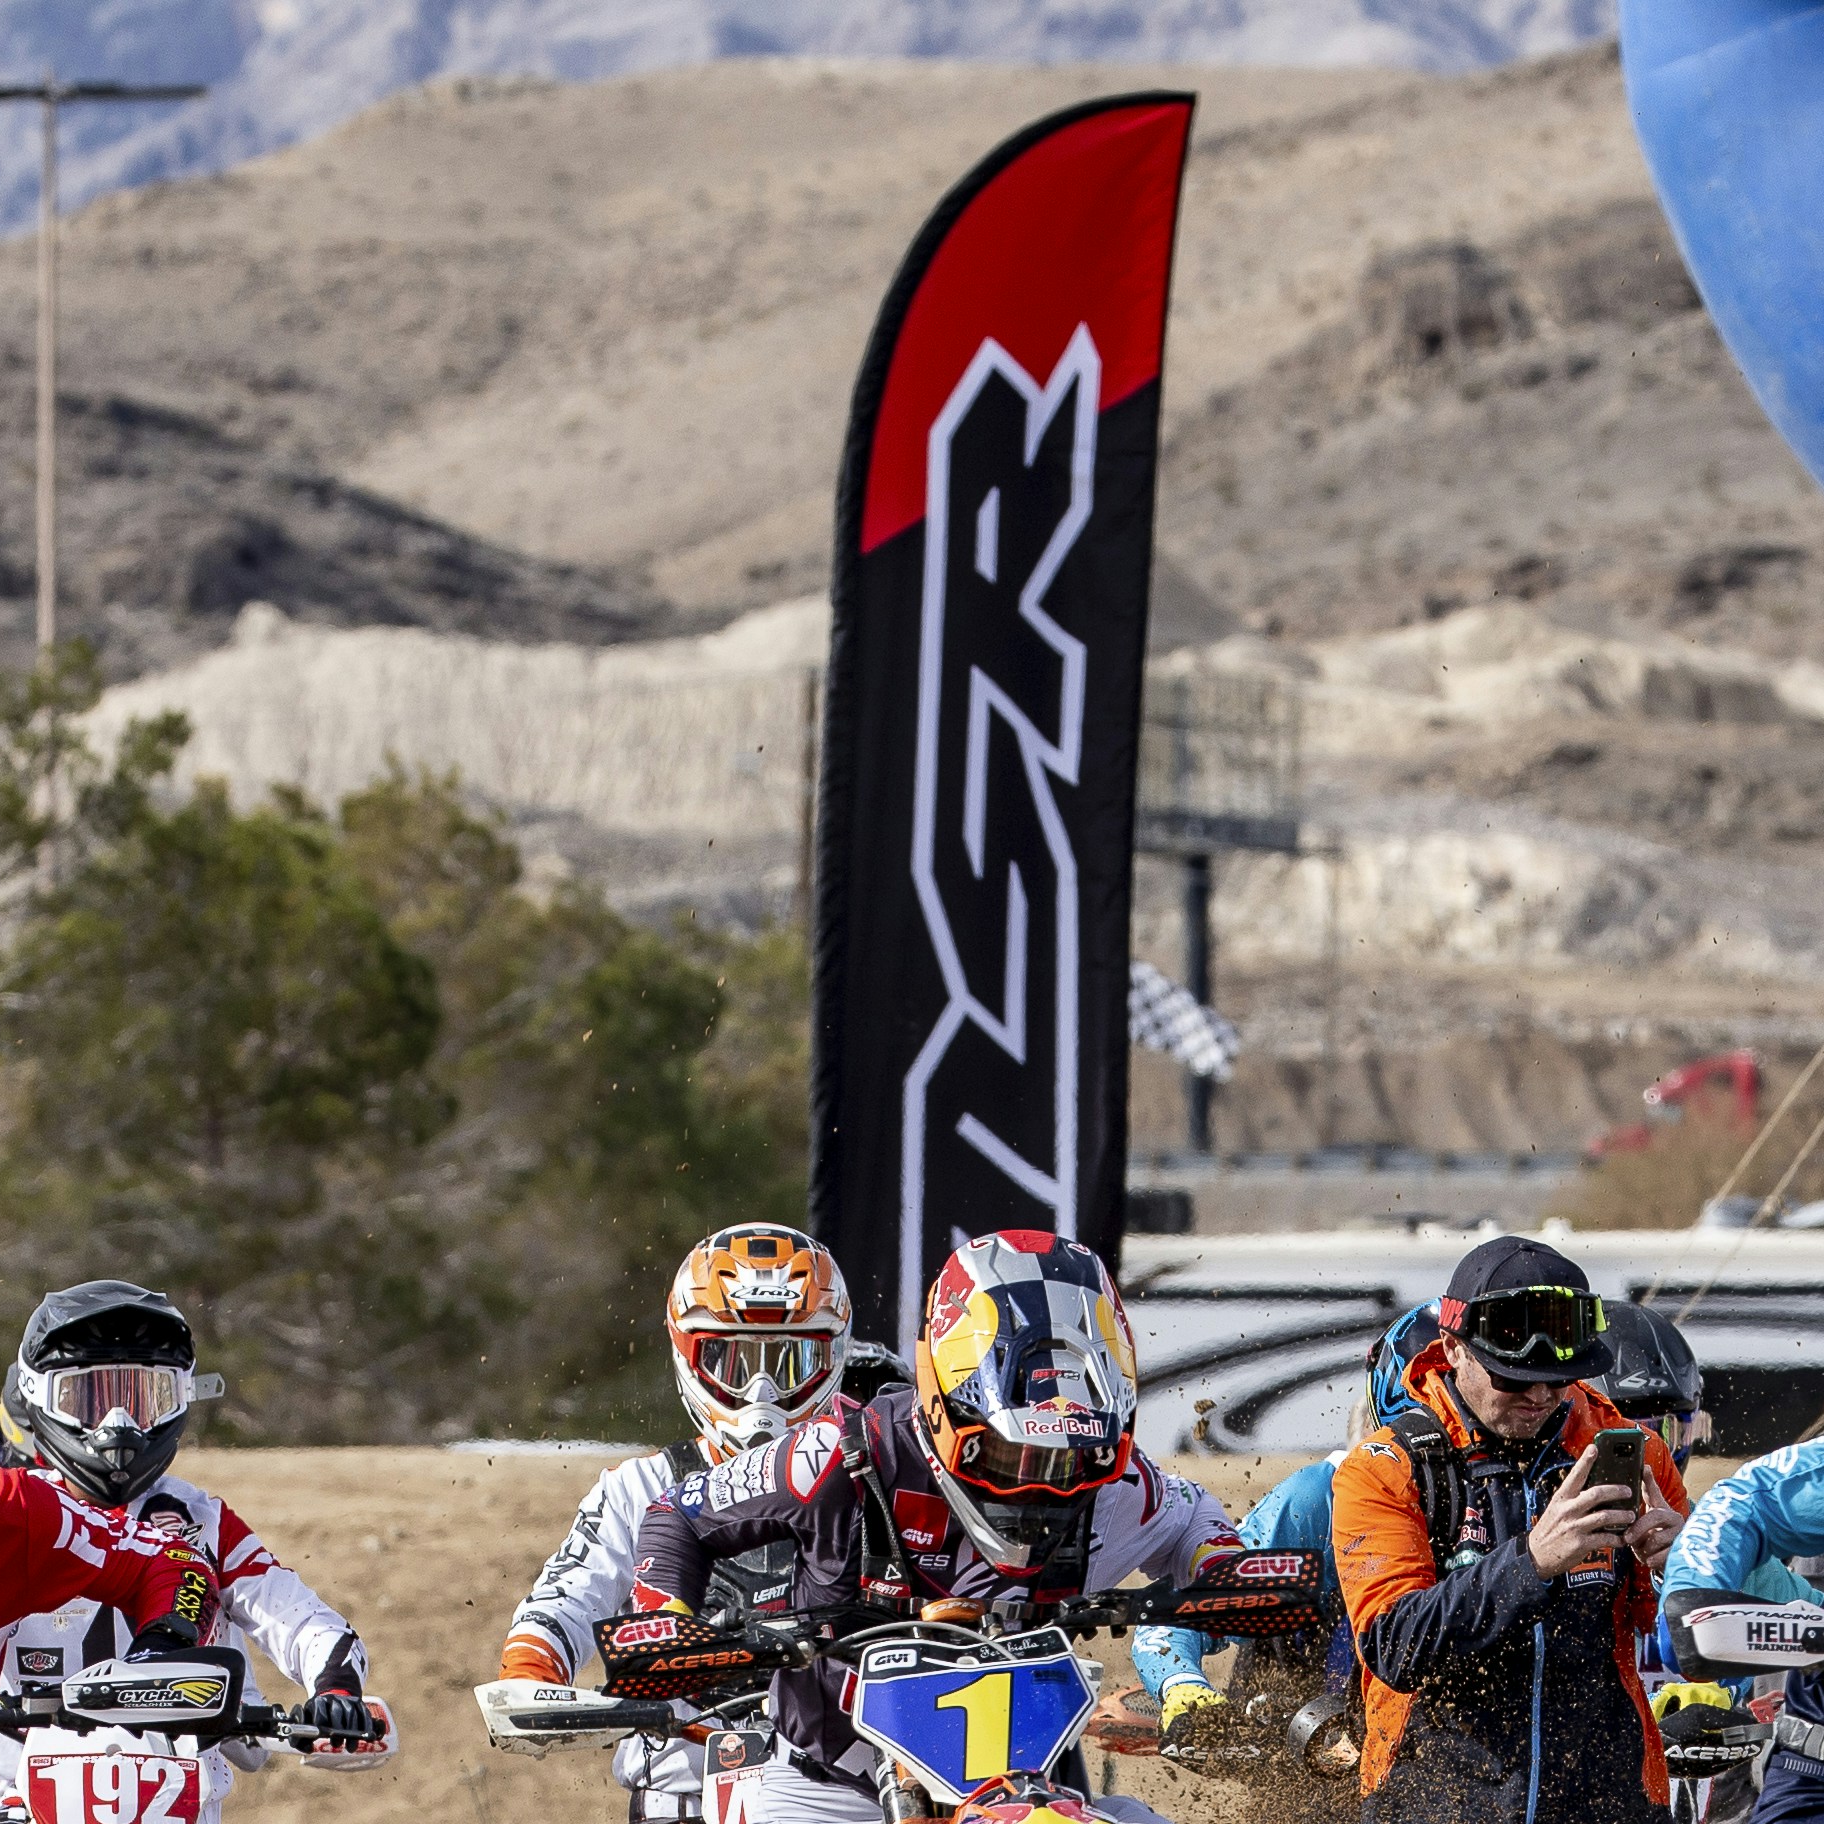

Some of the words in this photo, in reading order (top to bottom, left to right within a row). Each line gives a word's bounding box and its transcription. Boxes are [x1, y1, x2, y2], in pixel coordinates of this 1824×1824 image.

[1024, 1419, 1066, 1436] Red
[1065, 1418, 1103, 1437] Bull
[1410, 1432, 1441, 1444] OGIO
[901, 1528, 934, 1545] GIVI
[1239, 1557, 1302, 1575] GIVI
[753, 1583, 790, 1605] LEATT
[869, 1581, 903, 1597] LEATT
[1176, 1594, 1281, 1615] ACERBIS
[1757, 1609, 1823, 1621] RACING
[615, 1620, 675, 1643] GIVI
[1747, 1621, 1802, 1643] HELL
[1747, 1642, 1807, 1653] TRAINING
[647, 1650, 755, 1672] ACERBIS
[873, 1652, 910, 1666] GIVI
[118, 1688, 183, 1703] CYCRA
[936, 1672, 1012, 1781] 1
[1664, 1744, 1761, 1761] ACERBIS
